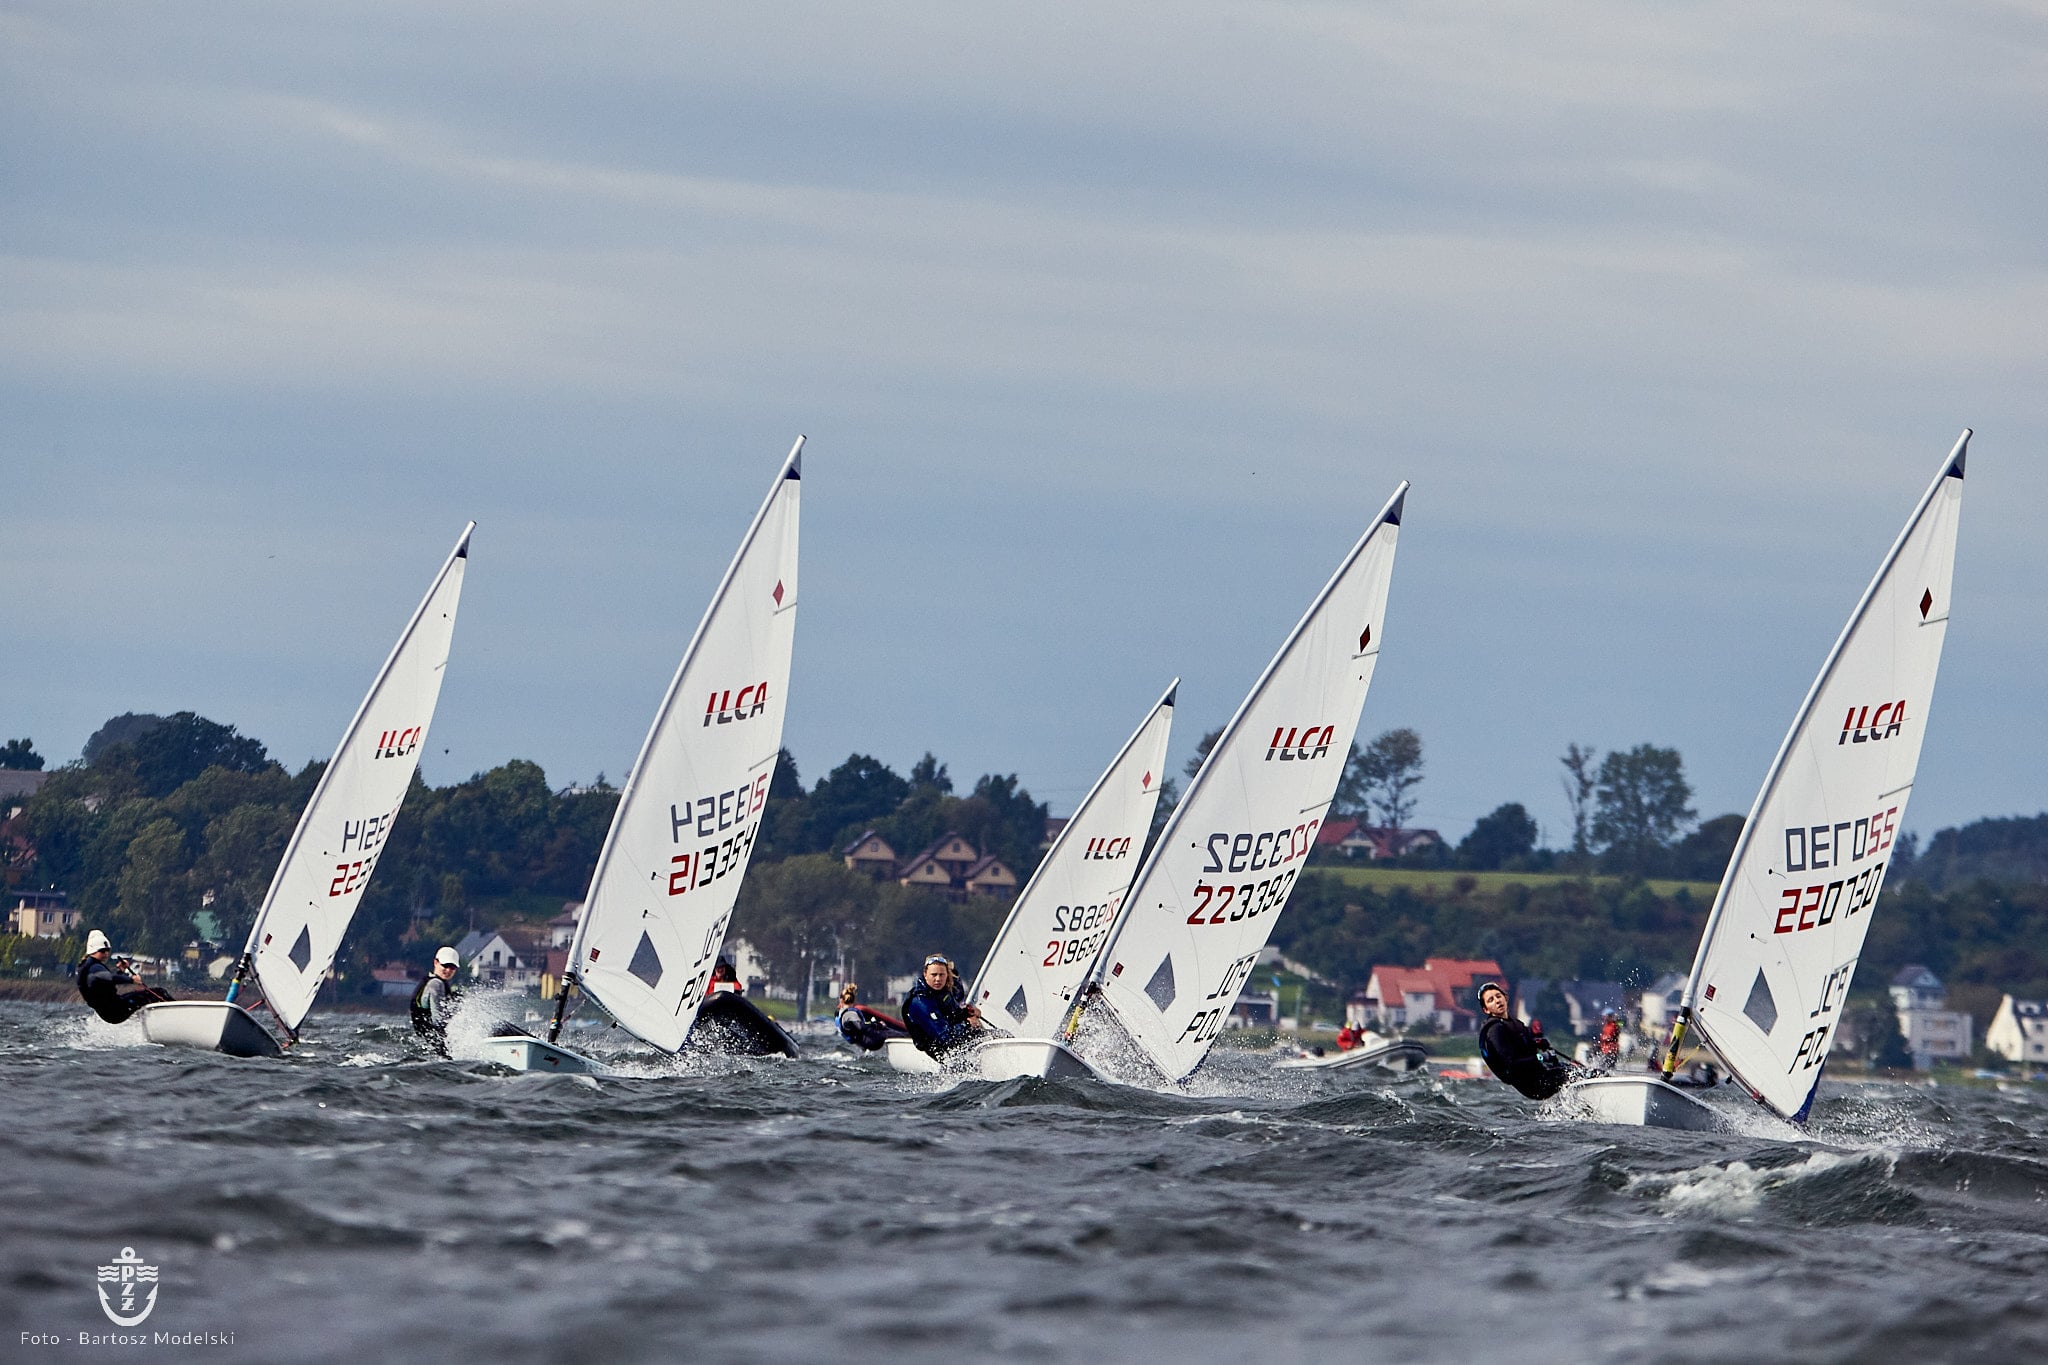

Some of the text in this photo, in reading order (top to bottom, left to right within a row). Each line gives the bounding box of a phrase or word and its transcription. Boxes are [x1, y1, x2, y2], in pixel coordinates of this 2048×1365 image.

[703, 681, 768, 727] ILCA
[1838, 699, 1906, 746] ILCA
[374, 726, 422, 760] ILCA
[1264, 725, 1335, 761] ILCA
[668, 821, 758, 897] 213354
[1083, 836, 1132, 861] ILCA
[1186, 867, 1297, 925] 223392
[1773, 861, 1885, 935] 220730
[1175, 1004, 1226, 1044] POL
